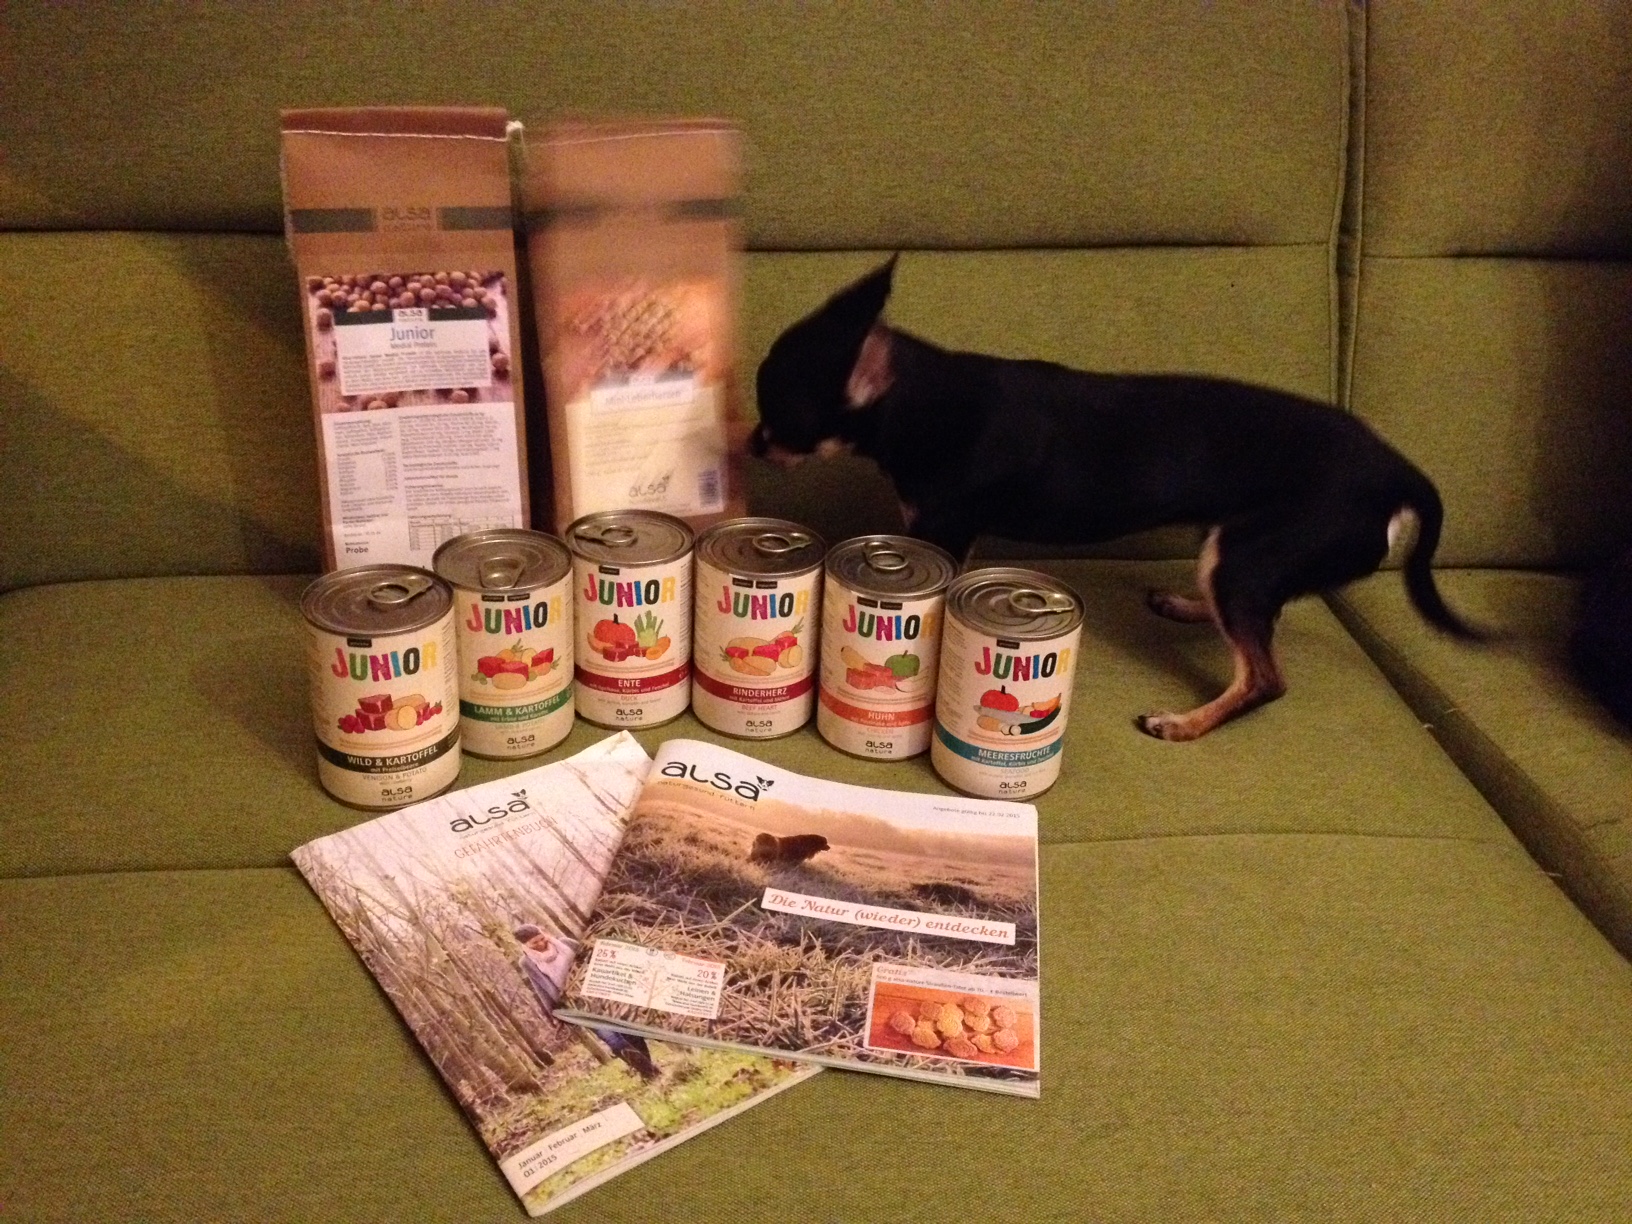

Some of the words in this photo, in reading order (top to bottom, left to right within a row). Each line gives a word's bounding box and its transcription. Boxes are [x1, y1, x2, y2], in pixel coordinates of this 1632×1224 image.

[390, 326, 435, 341] Junior
[346, 546, 369, 554] Probe
[583, 573, 676, 608] JUNIOR
[717, 585, 810, 620] JUNIOR
[466, 595, 561, 635] JUNIOR
[842, 604, 936, 642] JUNIOR
[331, 641, 437, 682] JUNIOR
[974, 646, 1071, 682] JUNIOR
[618, 679, 641, 688] ENTE
[733, 687, 788, 698] RINDERHERZ
[474, 705, 503, 716] LAMM
[505, 707, 513, 716] &
[515, 695, 560, 715] KARTOFFEL
[868, 712, 895, 721] HUHN
[347, 755, 372, 767] WILD
[375, 758, 383, 767] &
[386, 745, 438, 766] KARTOFFEL
[362, 773, 393, 781] VENISON
[769, 893, 797, 909] Die
[801, 900, 850, 918] Natur
[855, 908, 921, 929] (wieder)
[926, 920, 1009, 939] entdecken
[597, 949, 608, 958] 25
[610, 950, 617, 959] %
[697, 969, 710, 979] 20
[711, 971, 718, 980] %
[518, 1150, 543, 1169] Januar
[548, 1132, 577, 1151] Februar
[583, 1122, 602, 1134] März
[538, 1155, 558, 1169] 2015
